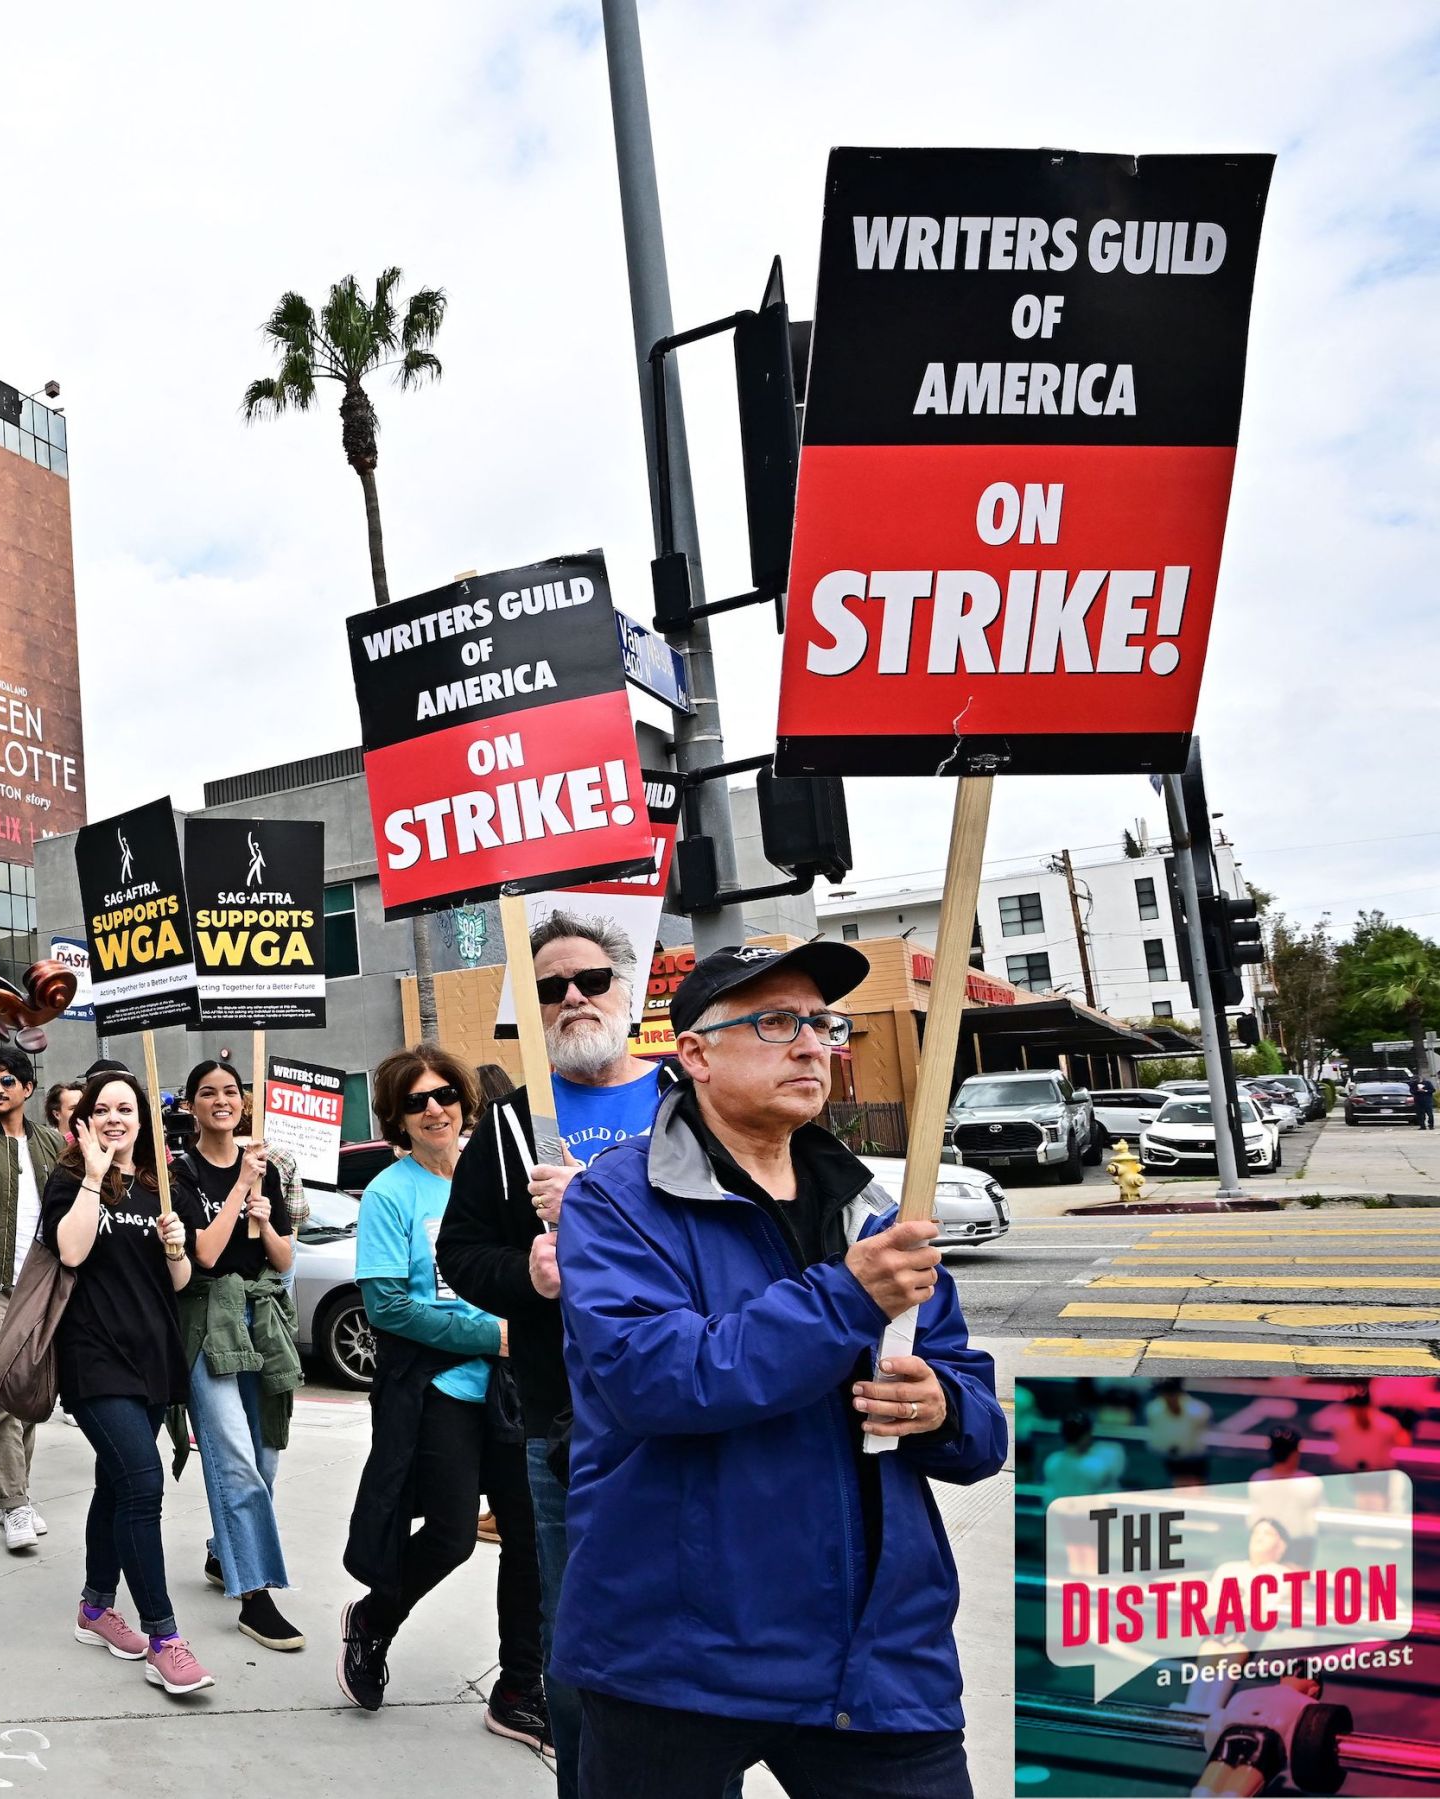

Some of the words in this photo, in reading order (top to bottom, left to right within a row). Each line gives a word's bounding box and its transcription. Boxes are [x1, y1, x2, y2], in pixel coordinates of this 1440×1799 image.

[853, 216, 1077, 271] WRITERS
[1088, 221, 1227, 275] GUILD
[1012, 295, 1064, 340] OF
[913, 363, 1136, 416] AMERICA
[976, 482, 1064, 545] ON
[362, 599, 493, 662] WRITERS
[497, 576, 594, 621] GUILD
[806, 566, 1191, 675] STRIKE!
[461, 637, 493, 667] OF
[618, 615, 642, 658] Van
[645, 633, 673, 676] Ness
[416, 660, 557, 721] AMERICA
[467, 732, 524, 776] ON
[25, 792, 51, 811] story
[383, 759, 636, 870] STRIKE!
[644, 782, 675, 809] UILD
[92, 895, 179, 934] SUPPORTS
[196, 910, 315, 928] SUPPORTS
[95, 919, 184, 971] WGA
[196, 930, 314, 967] WGA
[117, 982, 138, 994] Together
[152, 977, 168, 987] Better
[170, 974, 188, 984] Future
[198, 984, 220, 992] Acting
[222, 983, 255, 992] Together
[256, 983, 265, 991] for
[294, 982, 316, 990] Future
[634, 1029, 675, 1044] TIRE
[273, 1064, 313, 1084] WRITERS
[314, 1072, 340, 1089] GUILD
[271, 1087, 338, 1121] STRIKE!
